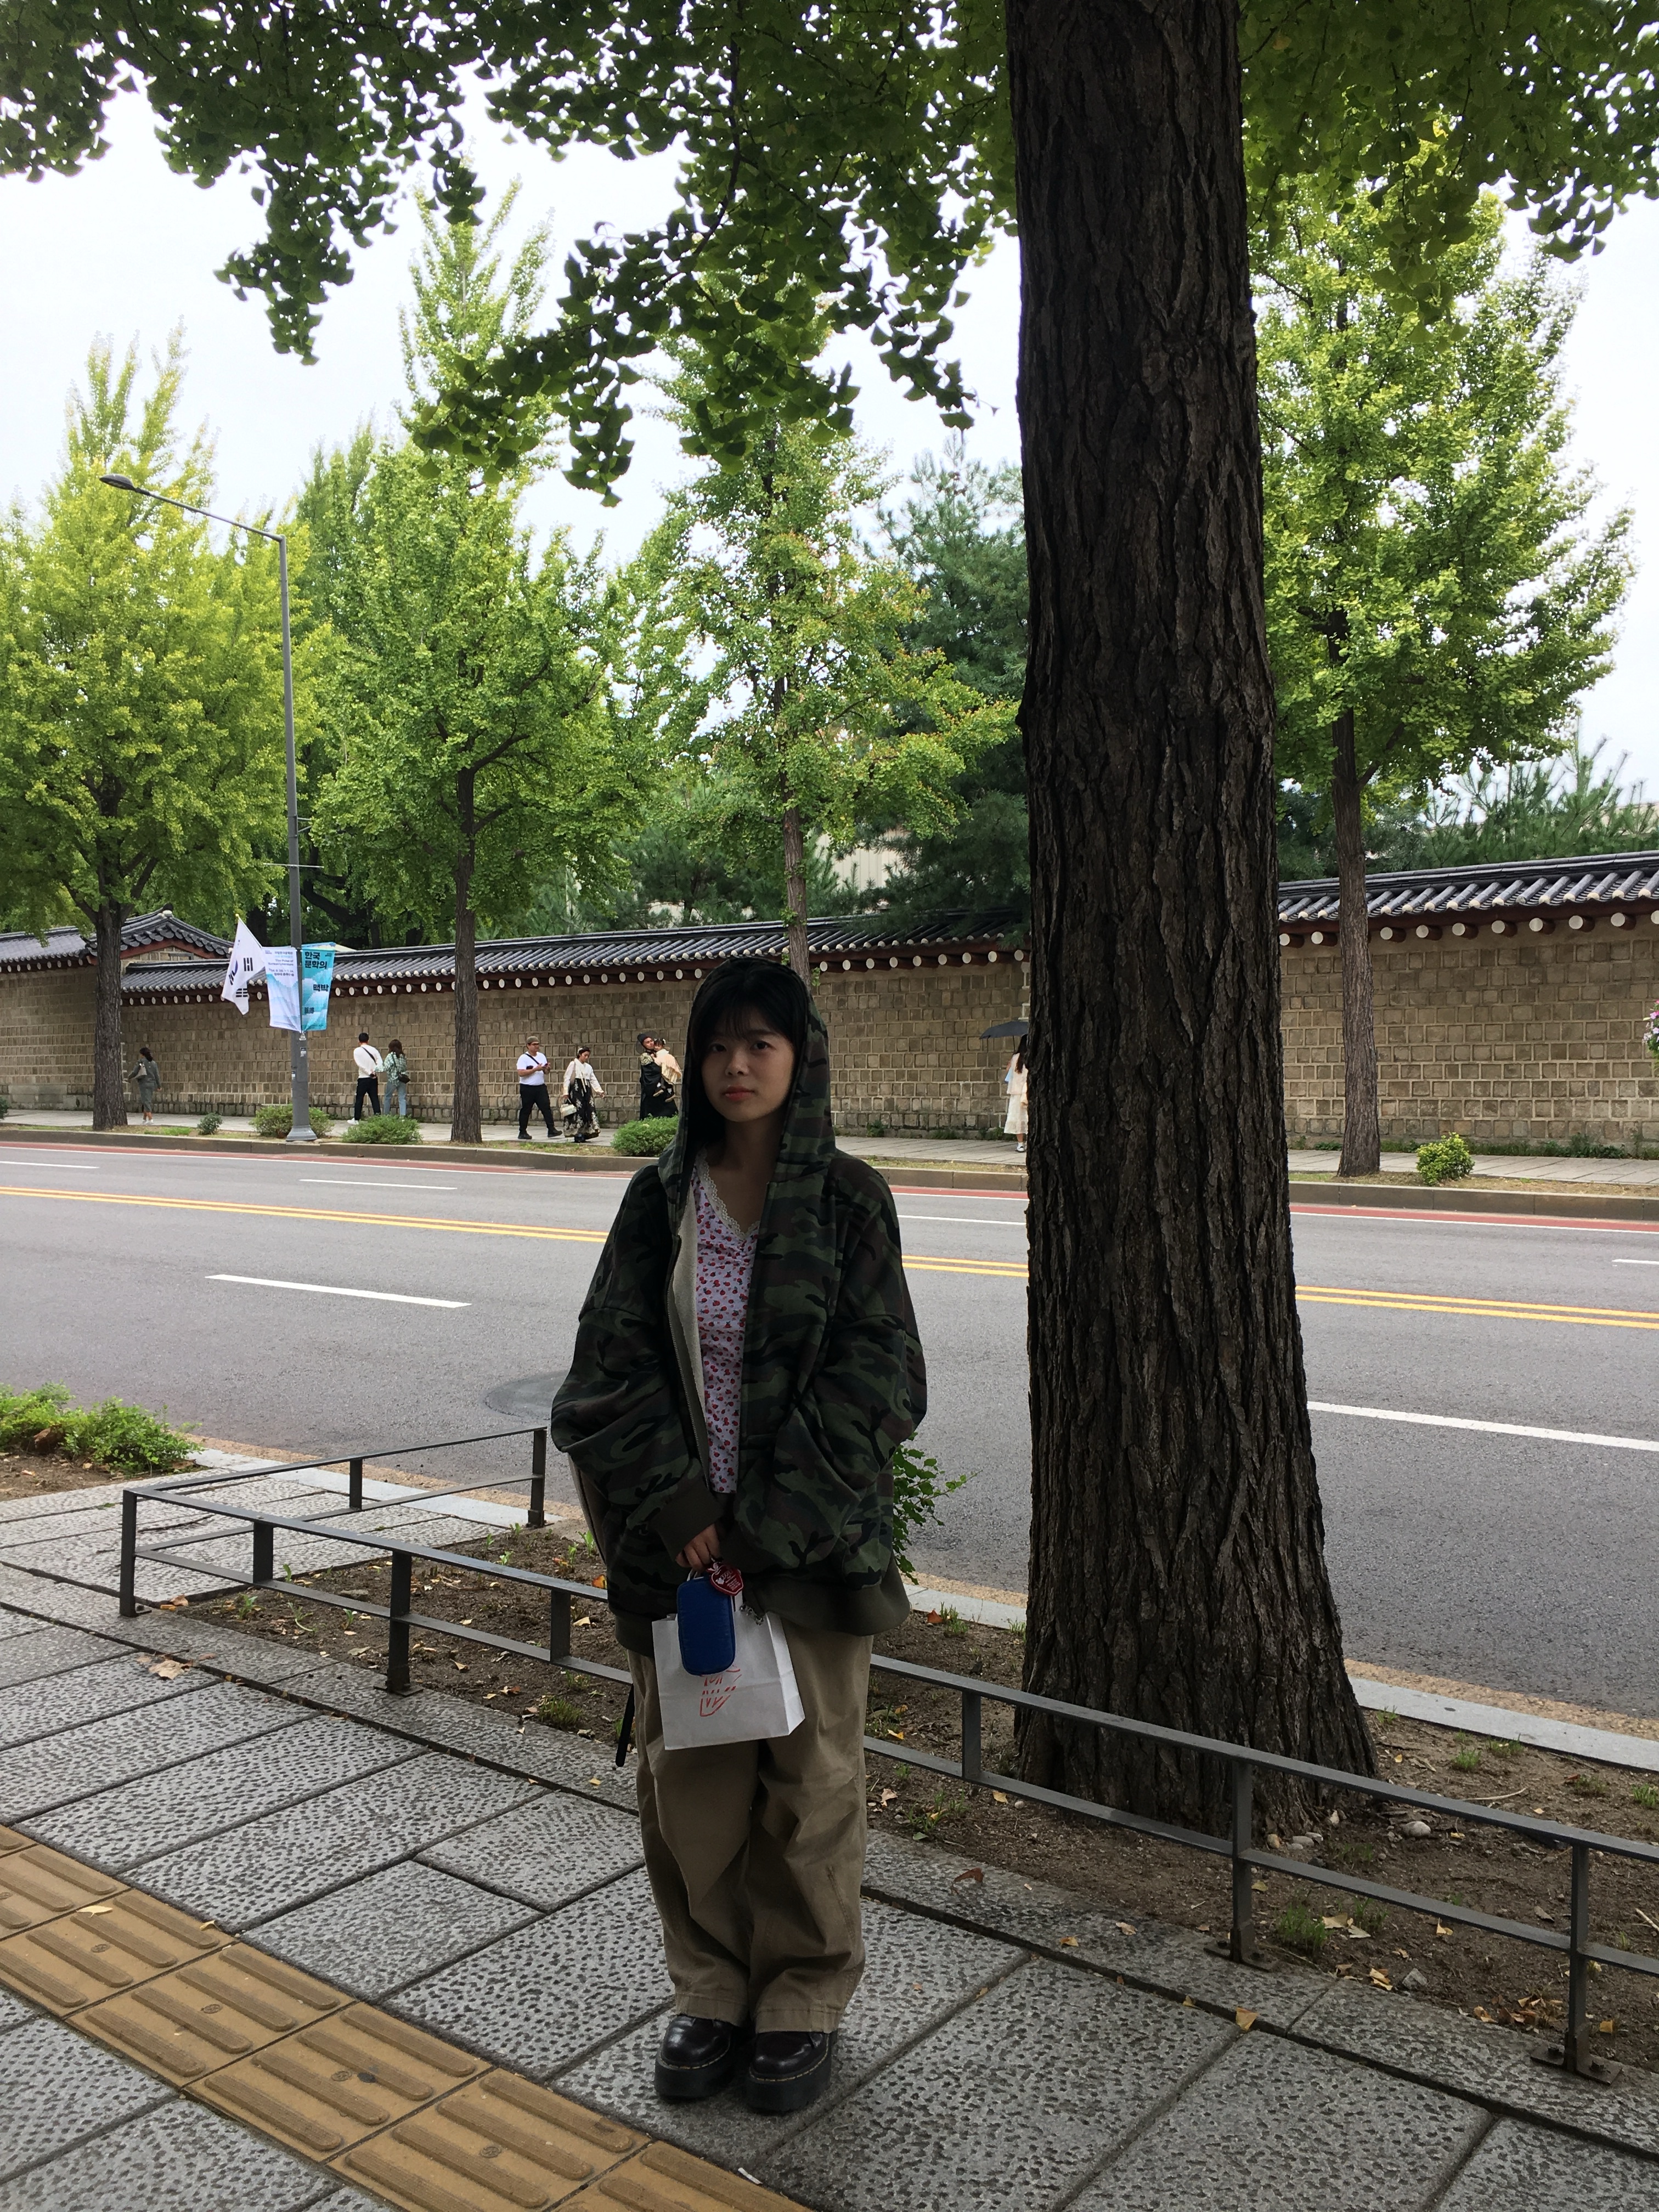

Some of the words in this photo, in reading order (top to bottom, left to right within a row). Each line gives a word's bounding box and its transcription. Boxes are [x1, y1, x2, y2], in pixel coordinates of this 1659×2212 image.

[304, 951, 320, 960] 한국
[304, 960, 328, 969] 문학의
[313, 984, 329, 992] 맥박
